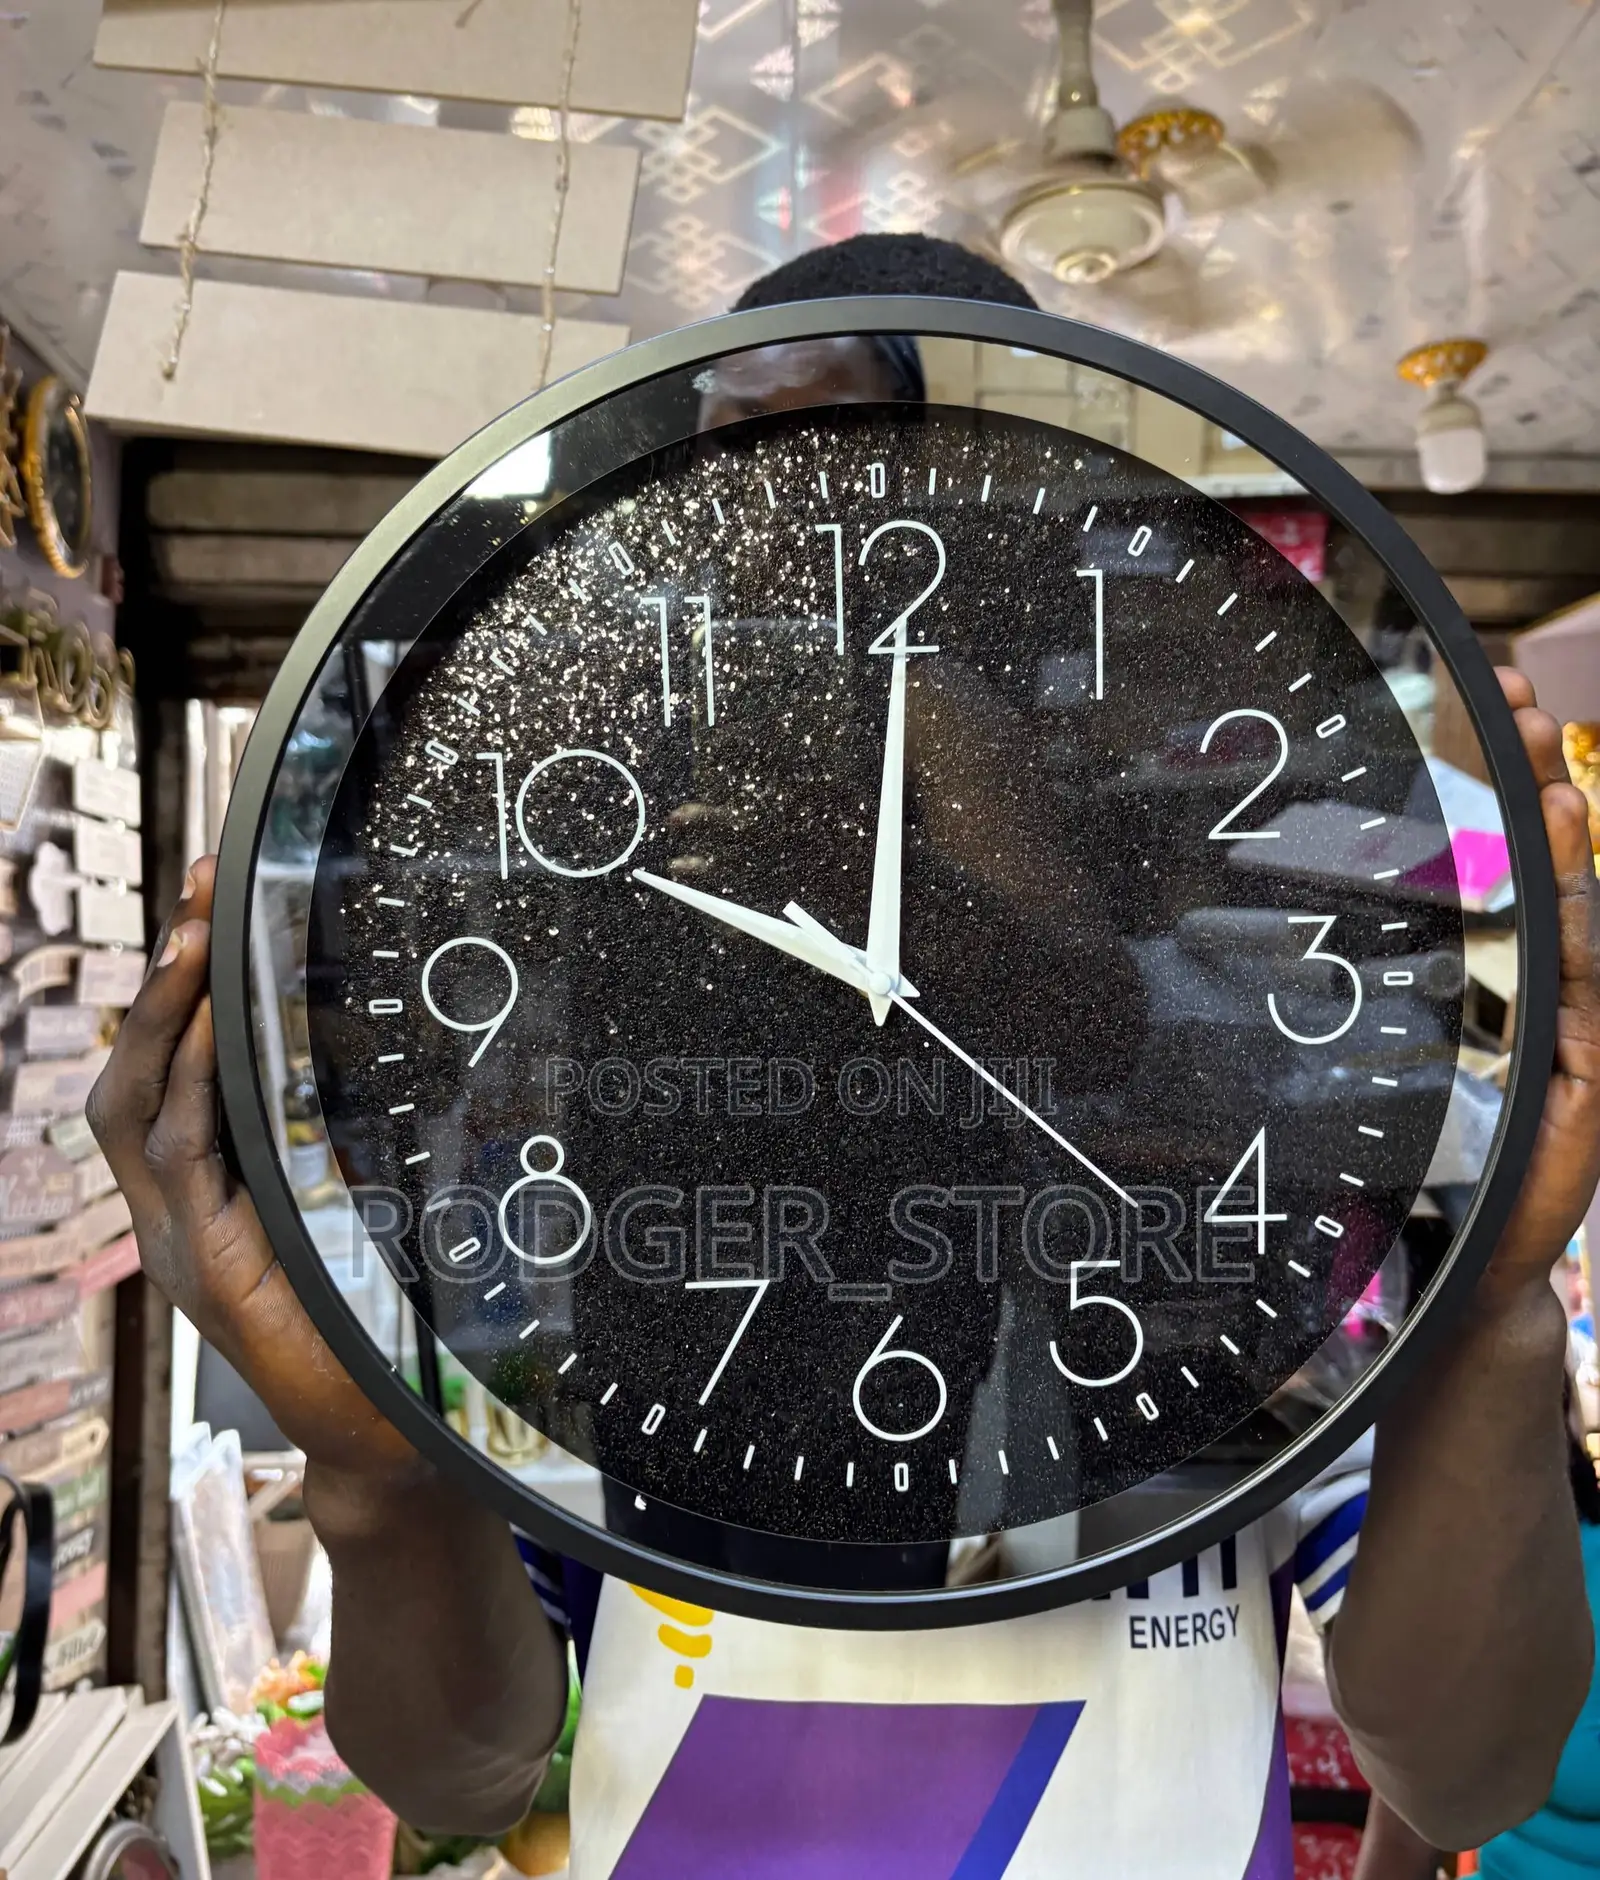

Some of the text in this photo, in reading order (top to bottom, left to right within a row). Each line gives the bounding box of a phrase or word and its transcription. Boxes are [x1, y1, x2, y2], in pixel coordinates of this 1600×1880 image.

[815, 519, 948, 656] 12
[1076, 568, 1105, 702] 1
[640, 595, 716, 728] 11
[476, 748, 647, 881] 10
[1199, 708, 1289, 841] 2
[420, 937, 519, 1068] 9
[1267, 915, 1363, 1046] 3
[498, 1134, 593, 1265] 8
[1203, 1125, 1289, 1256] 4
[684, 1279, 771, 1408] 7
[852, 1314, 948, 1443] 6
[1048, 1260, 1145, 1388] 5
[1129, 1604, 1240, 1650] ENERGY
